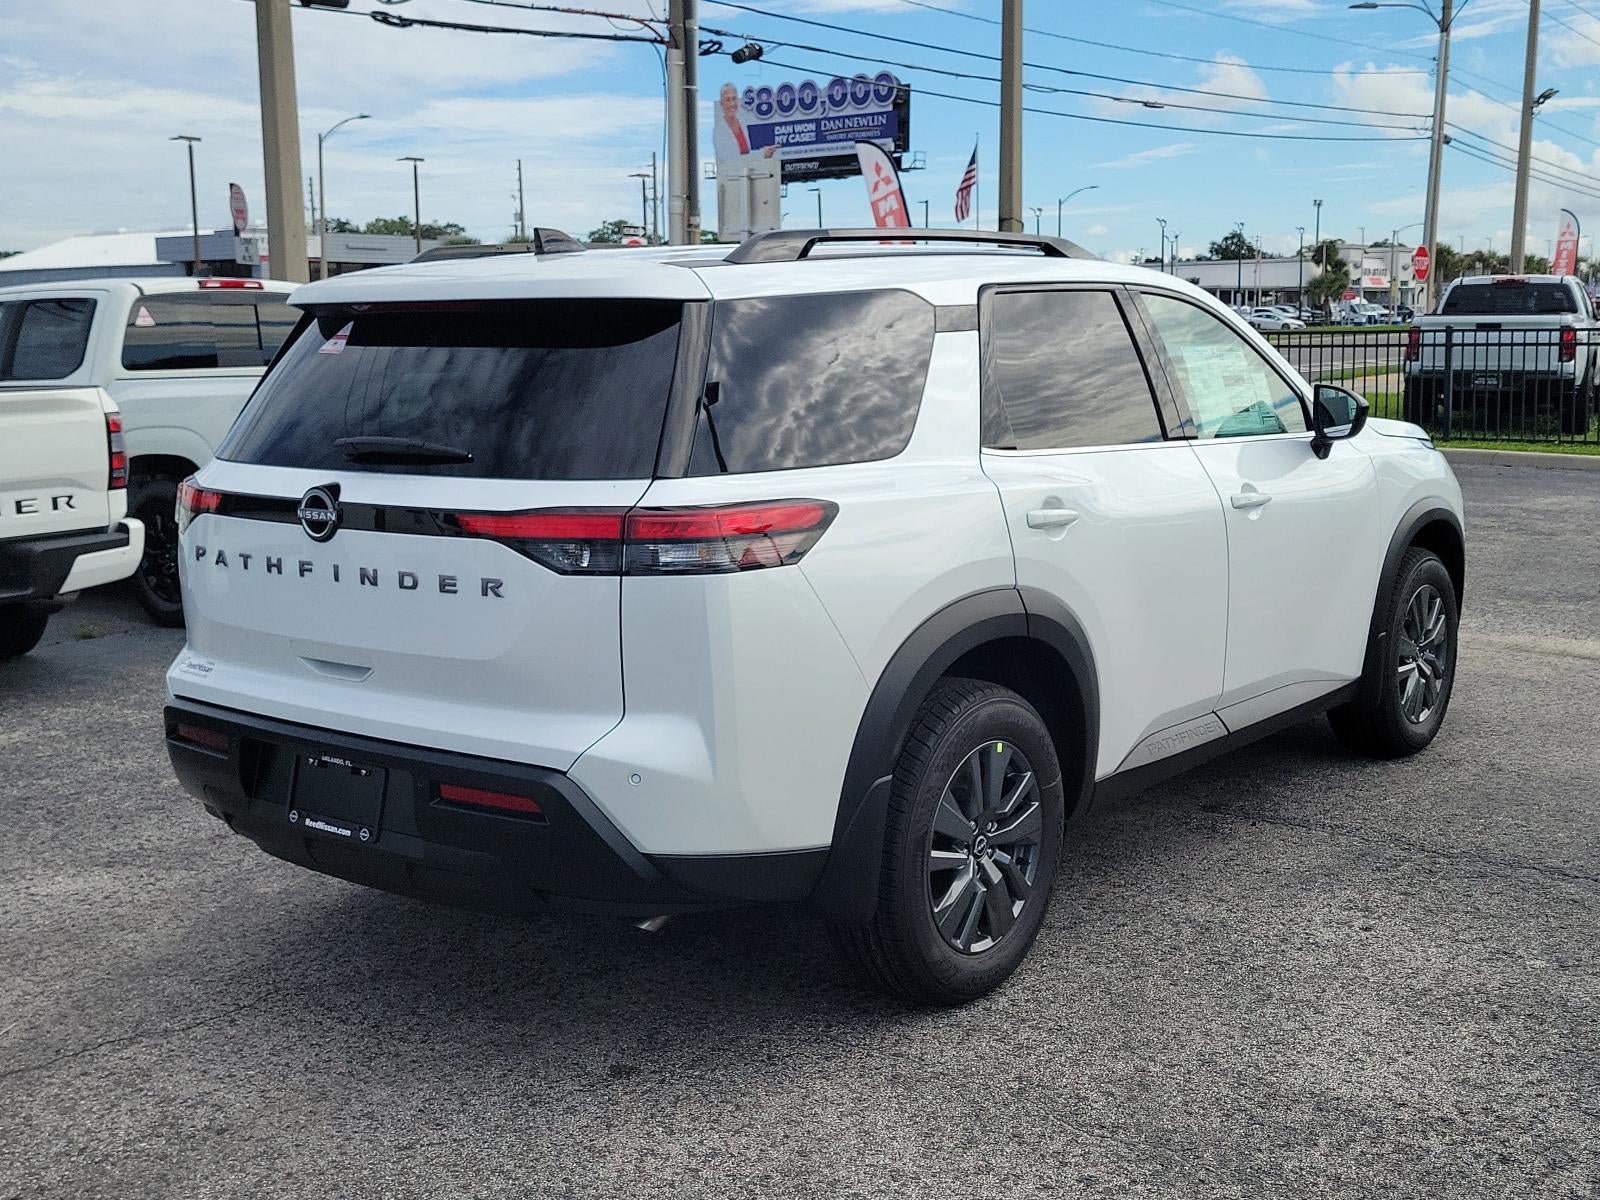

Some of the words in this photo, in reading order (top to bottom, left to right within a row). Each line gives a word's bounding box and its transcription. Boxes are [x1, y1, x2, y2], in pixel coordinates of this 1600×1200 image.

[743, 71, 897, 117] $800,000
[774, 125, 793, 135] DAN
[794, 122, 817, 133] WON
[820, 118, 844, 131] DAN
[845, 114, 887, 129] NEWLIN
[774, 134, 788, 145] MY
[1415, 256, 1429, 270] STOP
[297, 508, 336, 521] NISSAN
[195, 545, 505, 598] PATHFINDER
[1145, 720, 1222, 755] PATHFINDER
[305, 818, 351, 837] ReedNissan.com
